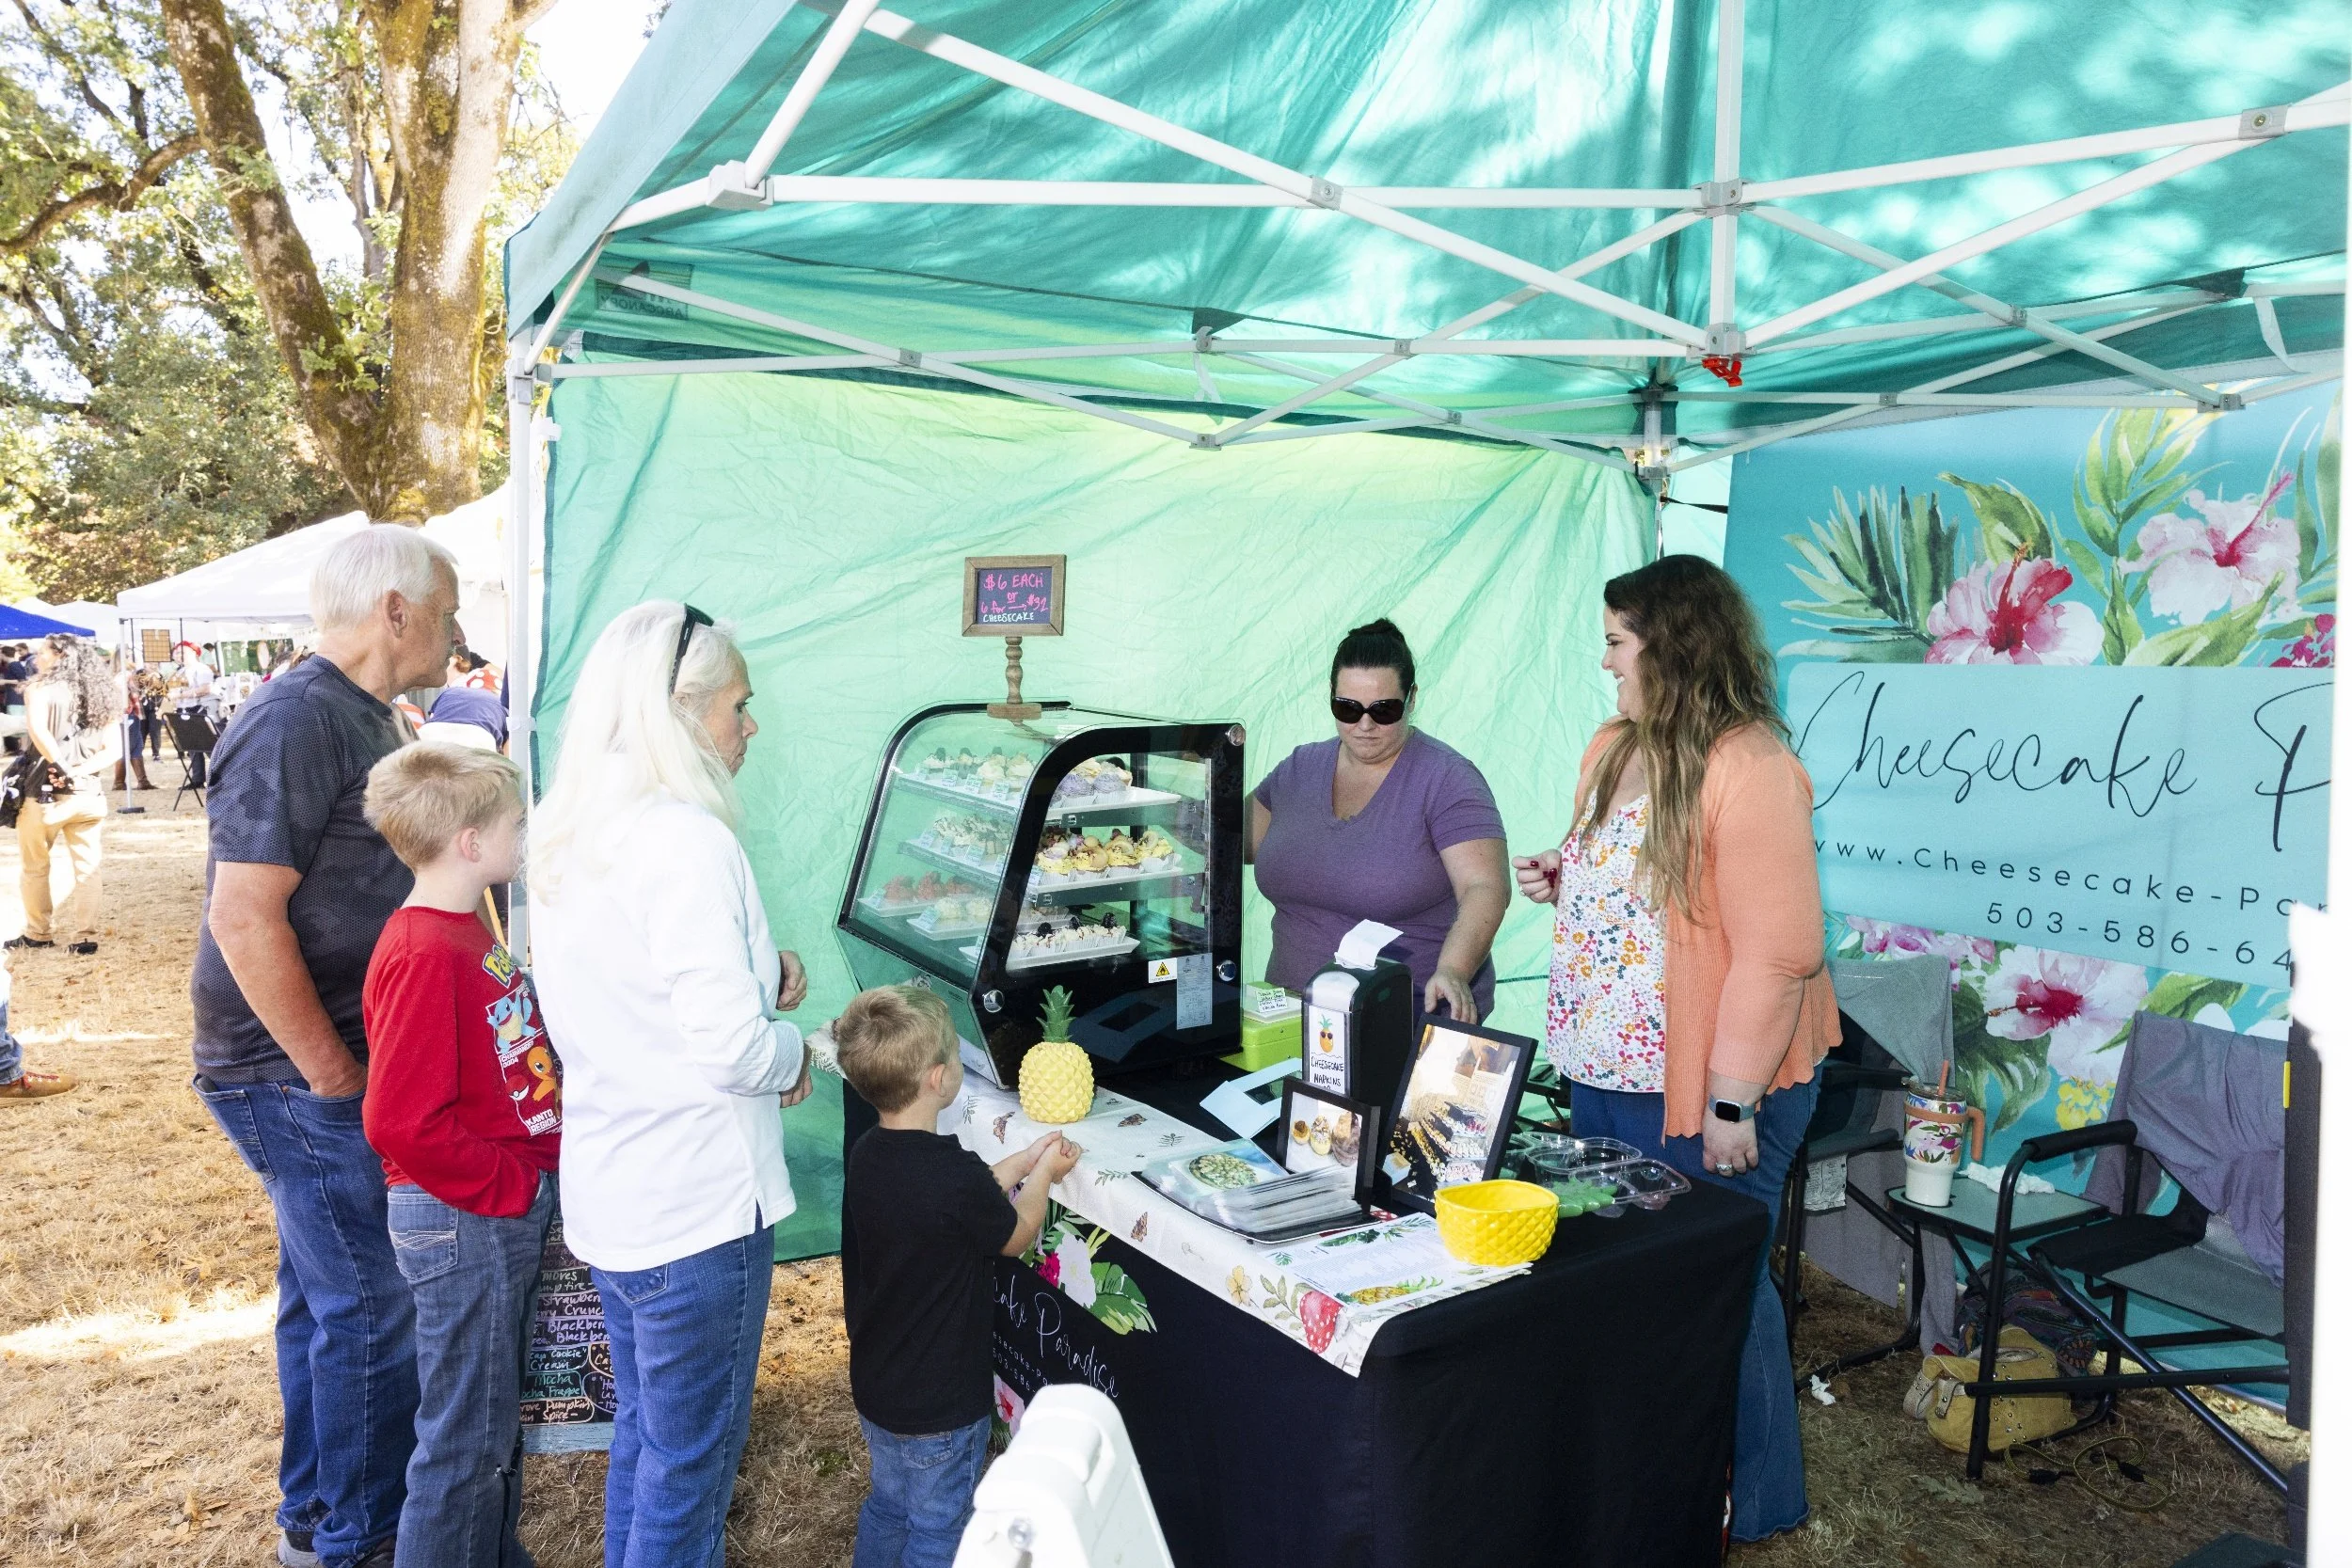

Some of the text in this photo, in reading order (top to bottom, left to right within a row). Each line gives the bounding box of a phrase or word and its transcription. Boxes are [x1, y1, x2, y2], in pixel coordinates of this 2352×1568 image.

[984, 573, 1044, 591] $6 EACH
[991, 600, 1006, 614] for
[983, 611, 1034, 622] CHEESECAKE
[1796, 671, 2198, 817] Cheesecake
[1987, 902, 2292, 971] 503-586-64
[1311, 1055, 1344, 1072] CHEESECAKE
[1313, 1072, 1342, 1087] NAPKINS
[525, 1109, 554, 1127] KANTO
[530, 1116, 557, 1134] REGION
[1035, 1291, 1120, 1398] Paradise
[530, 1359, 569, 1370] Cream
[522, 1387, 545, 1398] ocha
